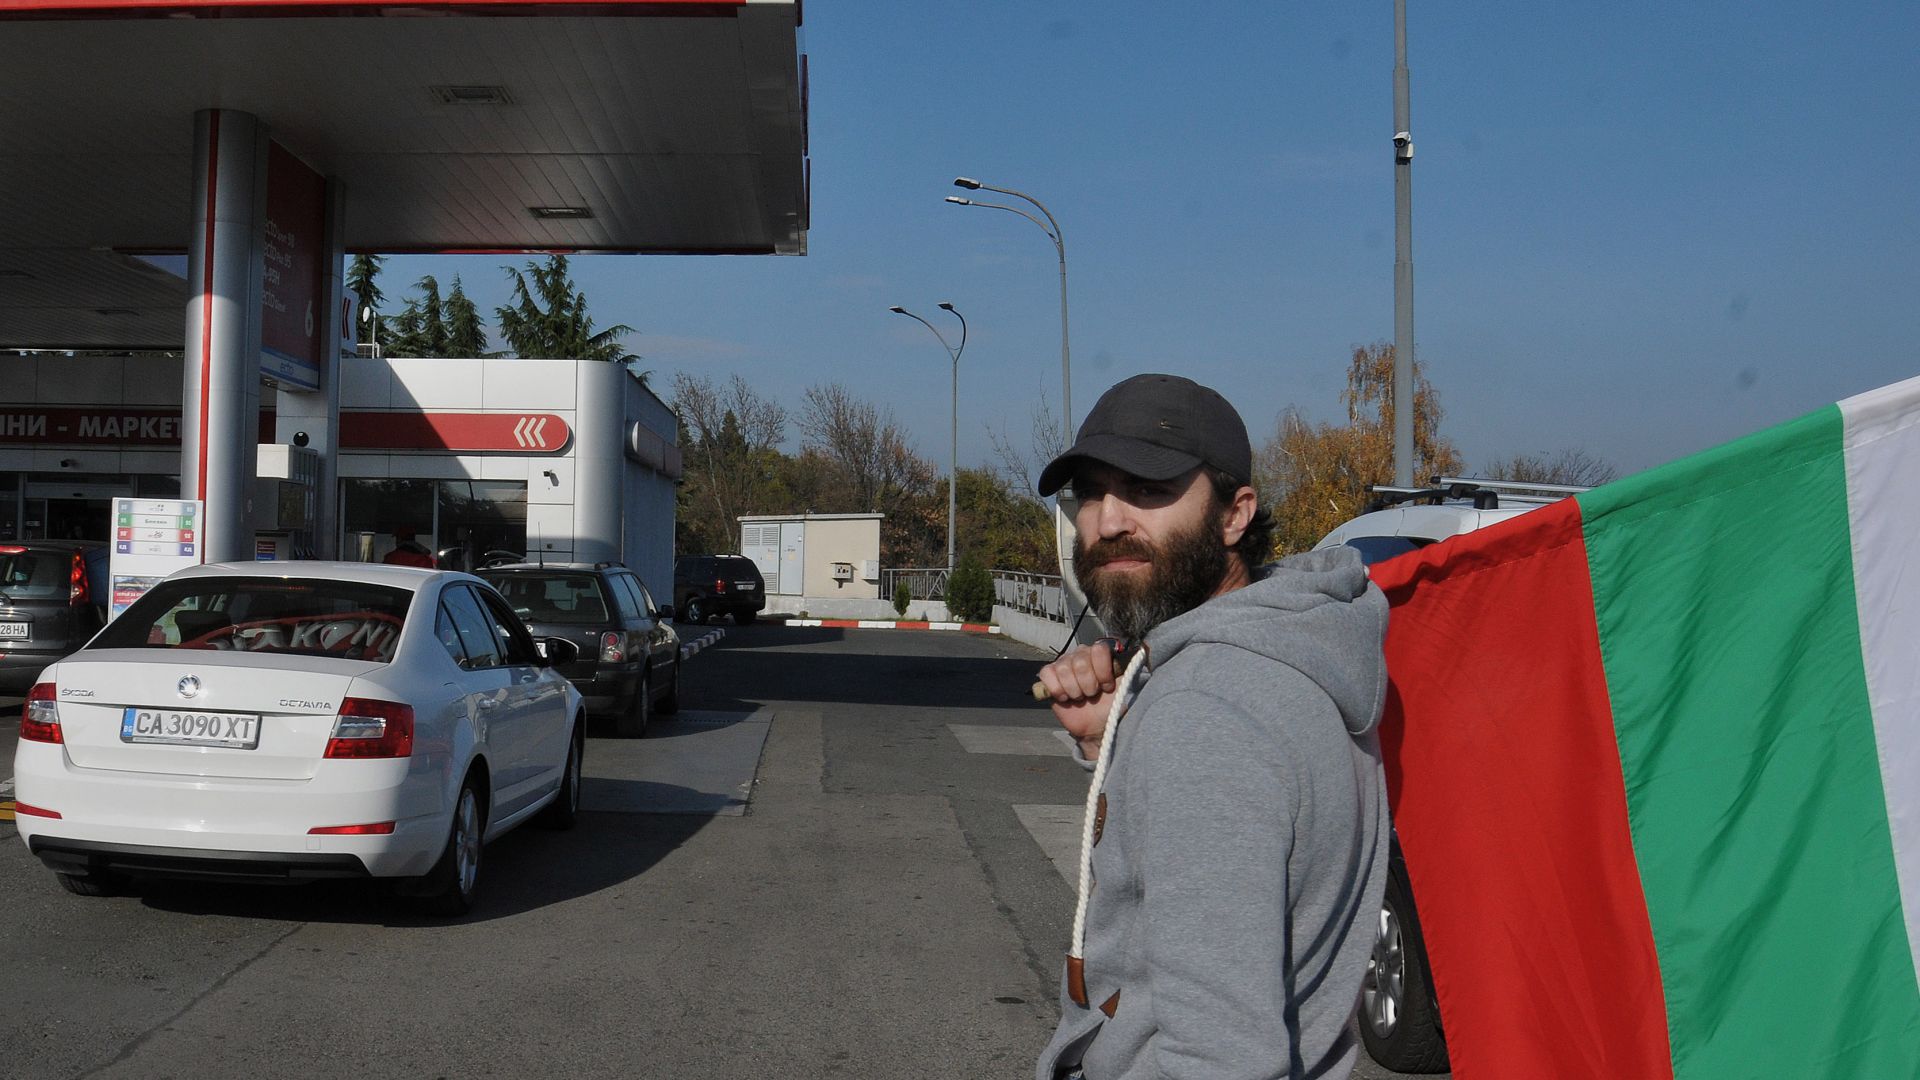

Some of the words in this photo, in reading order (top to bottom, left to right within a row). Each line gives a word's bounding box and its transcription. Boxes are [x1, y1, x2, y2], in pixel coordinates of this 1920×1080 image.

[305, 300, 314, 337] 6
[279, 698, 332, 710] OCTAVIA
[136, 712, 163, 735] CA
[166, 714, 221, 738] 3090
[224, 717, 255, 739] XT
